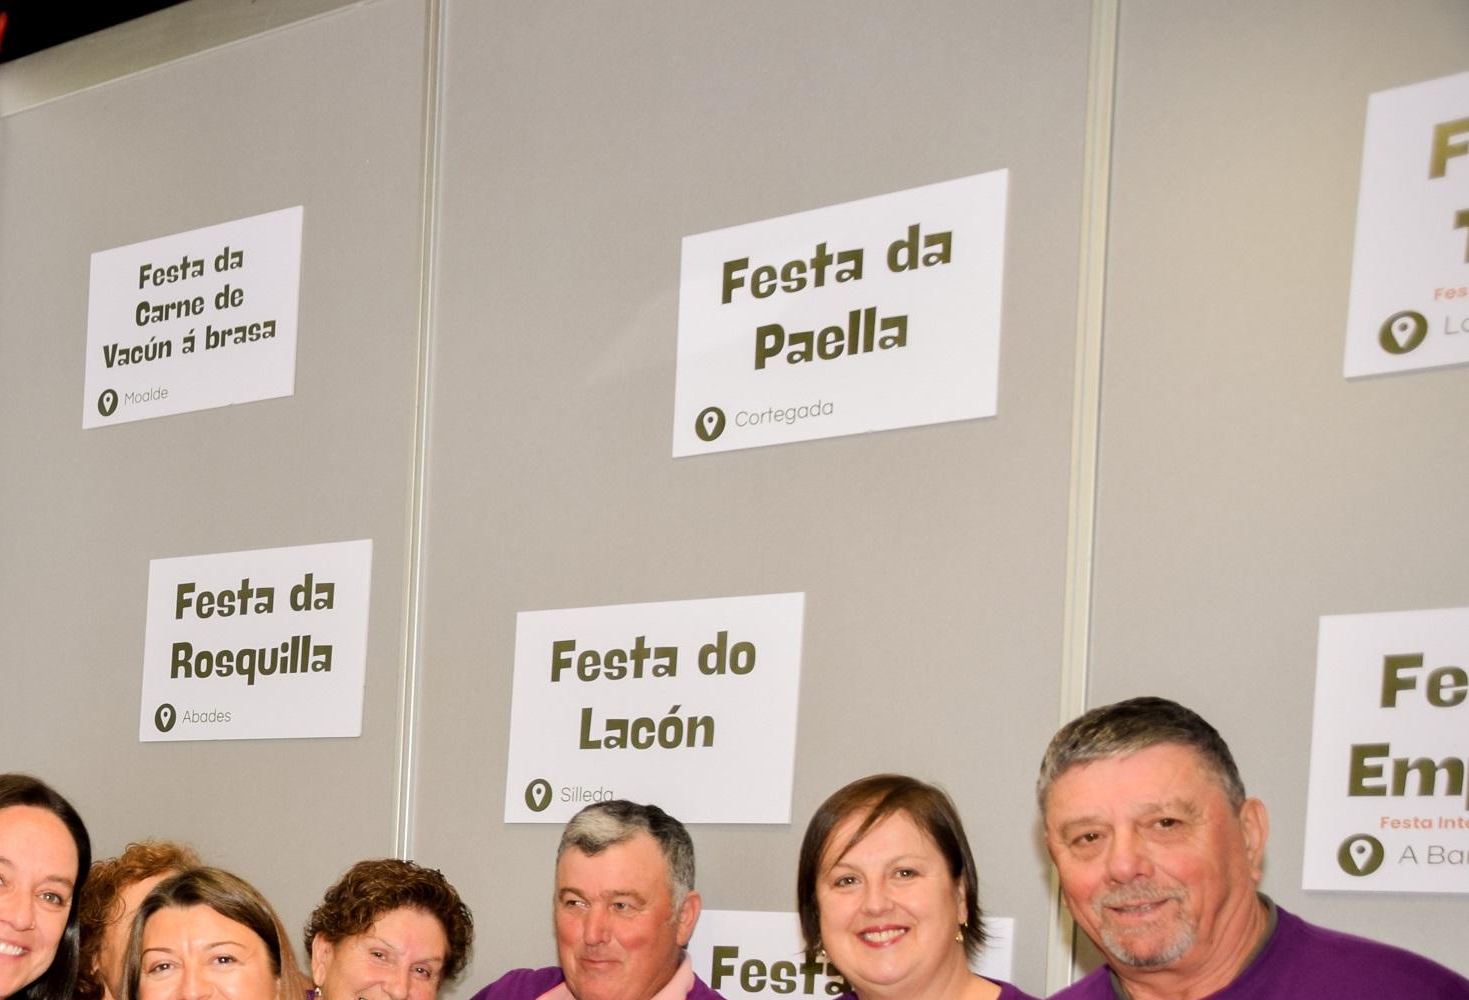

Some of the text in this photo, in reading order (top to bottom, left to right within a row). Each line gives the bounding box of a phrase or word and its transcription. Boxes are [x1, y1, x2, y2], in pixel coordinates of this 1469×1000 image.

[138, 247, 245, 289] Festa da
[721, 222, 954, 305] Festa da
[135, 284, 245, 327] Carne de
[103, 319, 277, 369] Vacún á brasa
[753, 306, 909, 371] Paella
[123, 385, 169, 406] Moalde
[735, 399, 834, 430] Cortegada
[175, 573, 335, 620] Festa da
[170, 635, 333, 686] Rosquilla
[550, 630, 757, 682] Festa do
[182, 708, 232, 725] Abades
[579, 705, 715, 750] Lacón
[561, 786, 613, 803] Silleda
[1347, 742, 1469, 811] Em
[1380, 816, 1432, 829] Festa
[1398, 845, 1418, 864] A
